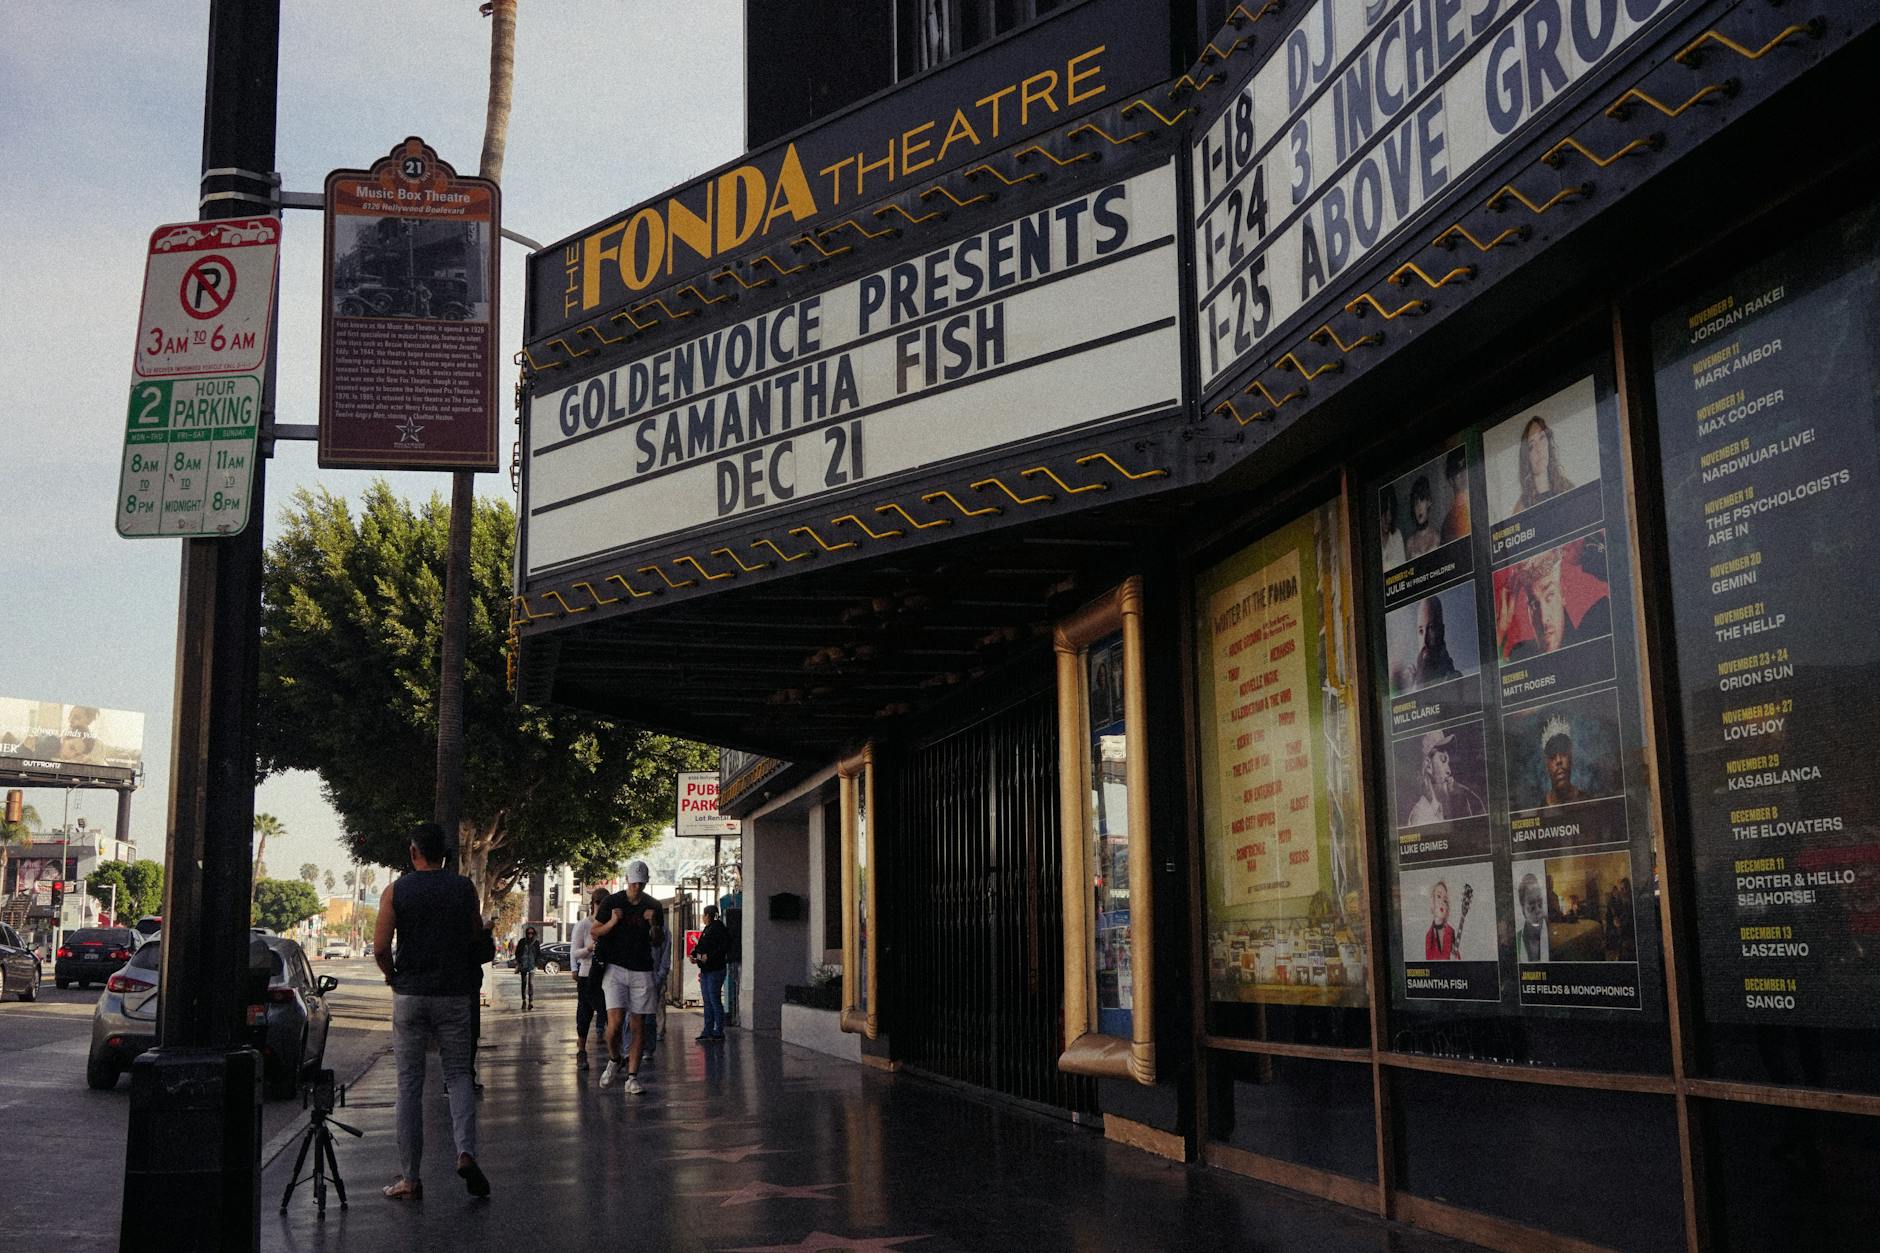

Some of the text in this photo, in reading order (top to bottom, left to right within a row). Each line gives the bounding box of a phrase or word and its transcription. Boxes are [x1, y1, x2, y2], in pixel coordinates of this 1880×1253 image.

[1287, 0, 1335, 114] DJ
[1291, 119, 1311, 205] 3
[1302, 0, 1658, 302] ABOVE GRO
[405, 161, 422, 174] 21
[565, 45, 1106, 318] THE FONDA THEATRE
[356, 186, 471, 203] Music Box Theatre
[382, 202, 424, 212] Hollywood
[425, 205, 465, 215] Boulevard
[1204, 164, 1268, 291] 1-24
[559, 184, 1129, 437] GOLDENVOICE PRESENTS
[1208, 254, 1271, 376] 1-25
[1689, 299, 1727, 329] NOVEMBER
[1690, 286, 1784, 344] JORDAN RAKEI
[193, 330, 207, 344] TO
[1692, 346, 1732, 375] NOVEMBER
[1695, 339, 1782, 390] MARK AMBOR
[195, 380, 236, 397] HOUR
[635, 302, 1005, 473] SAMANTHA FISH
[138, 386, 162, 424] 2
[173, 395, 252, 428] PARKING
[1696, 393, 1736, 421] NOVEMBER
[1699, 389, 1784, 437] MAX COOPER
[1701, 442, 1740, 468] NOVEMBER
[1703, 428, 1816, 484] NARDWUAR LIVE!
[716, 420, 864, 516] DEC 21
[164, 500, 202, 513] MIDNIGHT
[1704, 489, 1744, 515] NOVEMBER
[1706, 469, 1850, 530] THE PSYCHOLOGISTS
[1493, 540, 1504, 554] LP
[1708, 522, 1749, 547] ARE IN
[1386, 582, 1406, 596] JULIE
[1413, 574, 1429, 586] FROST
[1430, 562, 1456, 578] CHILDREN
[1710, 555, 1750, 578] NOVEMBER
[1712, 571, 1757, 594] GEMINI
[1714, 602, 1765, 627] NOVEMBER 21
[1716, 614, 1786, 642] THE HELLP
[1718, 655, 1760, 676] NOVEMBER
[1720, 664, 1794, 692] ORION SUN
[1503, 674, 1556, 697] MATT ROGERS
[1393, 711, 1411, 725] WILL
[1411, 704, 1440, 720] CLARKE
[1722, 704, 1764, 725] NOVEMBER
[1782, 699, 1793, 713] 27
[1724, 718, 1785, 741] LOVEJOY
[1727, 756, 1768, 773] NOVEMBER
[1728, 765, 1822, 791] KASABLANCA
[1731, 808, 1771, 824] DECEMBER
[1512, 823, 1580, 843] JEAN DAWSON
[1732, 817, 1843, 841] THE ELOVATERS
[1400, 839, 1449, 855] LUKE GRIMES
[1735, 857, 1785, 874] DECEMBER 11
[1737, 870, 1855, 890] PORTER & HELLO
[1738, 890, 1816, 907] SEAHORSE!
[1740, 926, 1792, 940] DECEMBER 13
[1407, 978, 1468, 990] SAMANTHA FISH
[1522, 984, 1634, 997] LEE FIELDS & MONOPHONICS
[1744, 978, 1797, 991] DECEMBER 14
[1746, 995, 1795, 1009] SANGO
